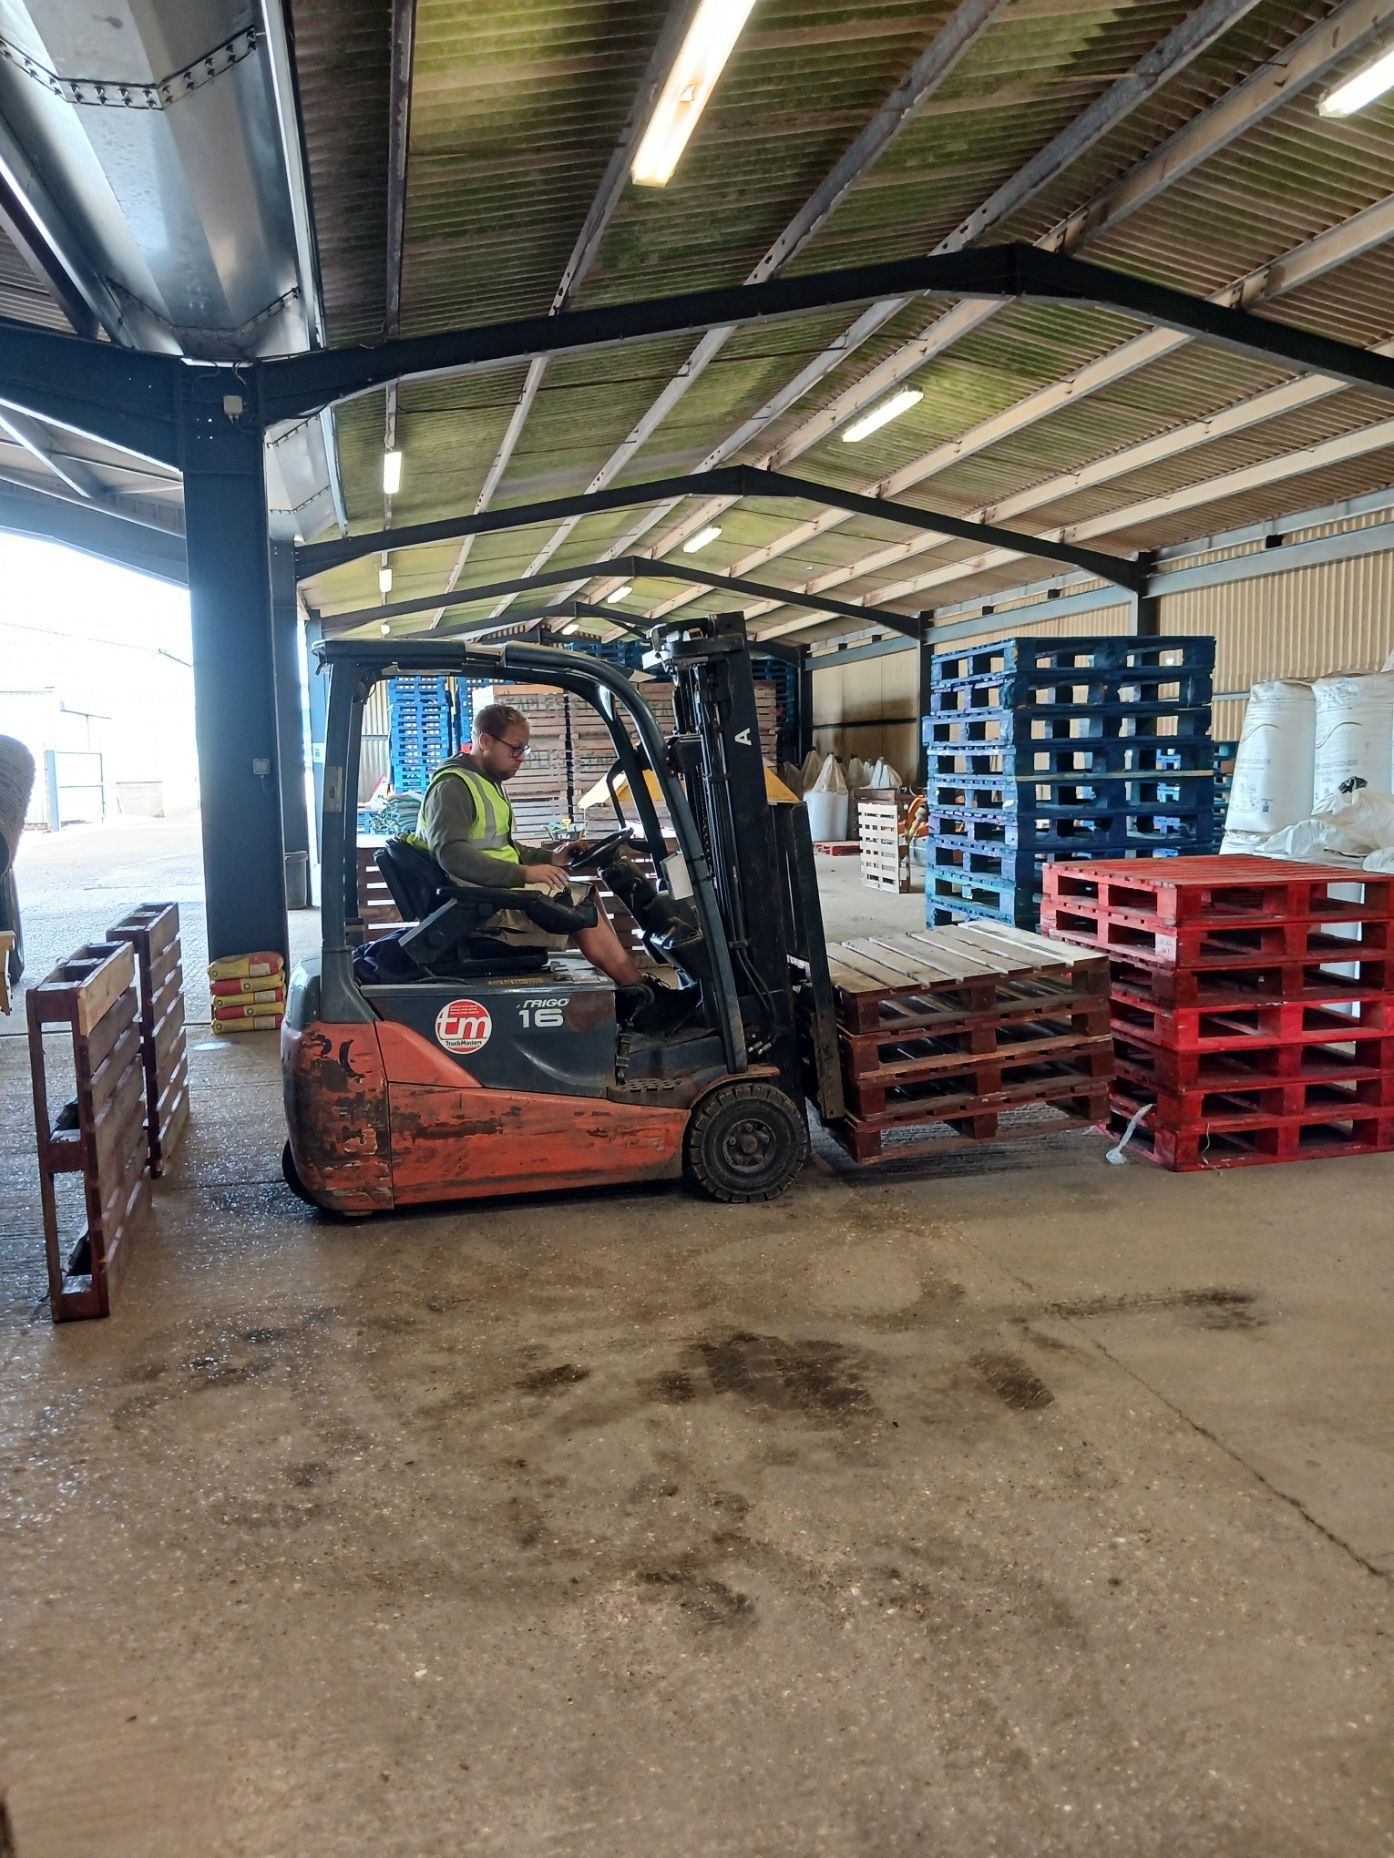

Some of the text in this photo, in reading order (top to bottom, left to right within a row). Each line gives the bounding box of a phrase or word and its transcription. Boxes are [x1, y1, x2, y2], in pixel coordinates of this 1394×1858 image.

[734, 727, 752, 746] A
[437, 1004, 492, 1039] tm
[518, 1008, 564, 1028] 16
